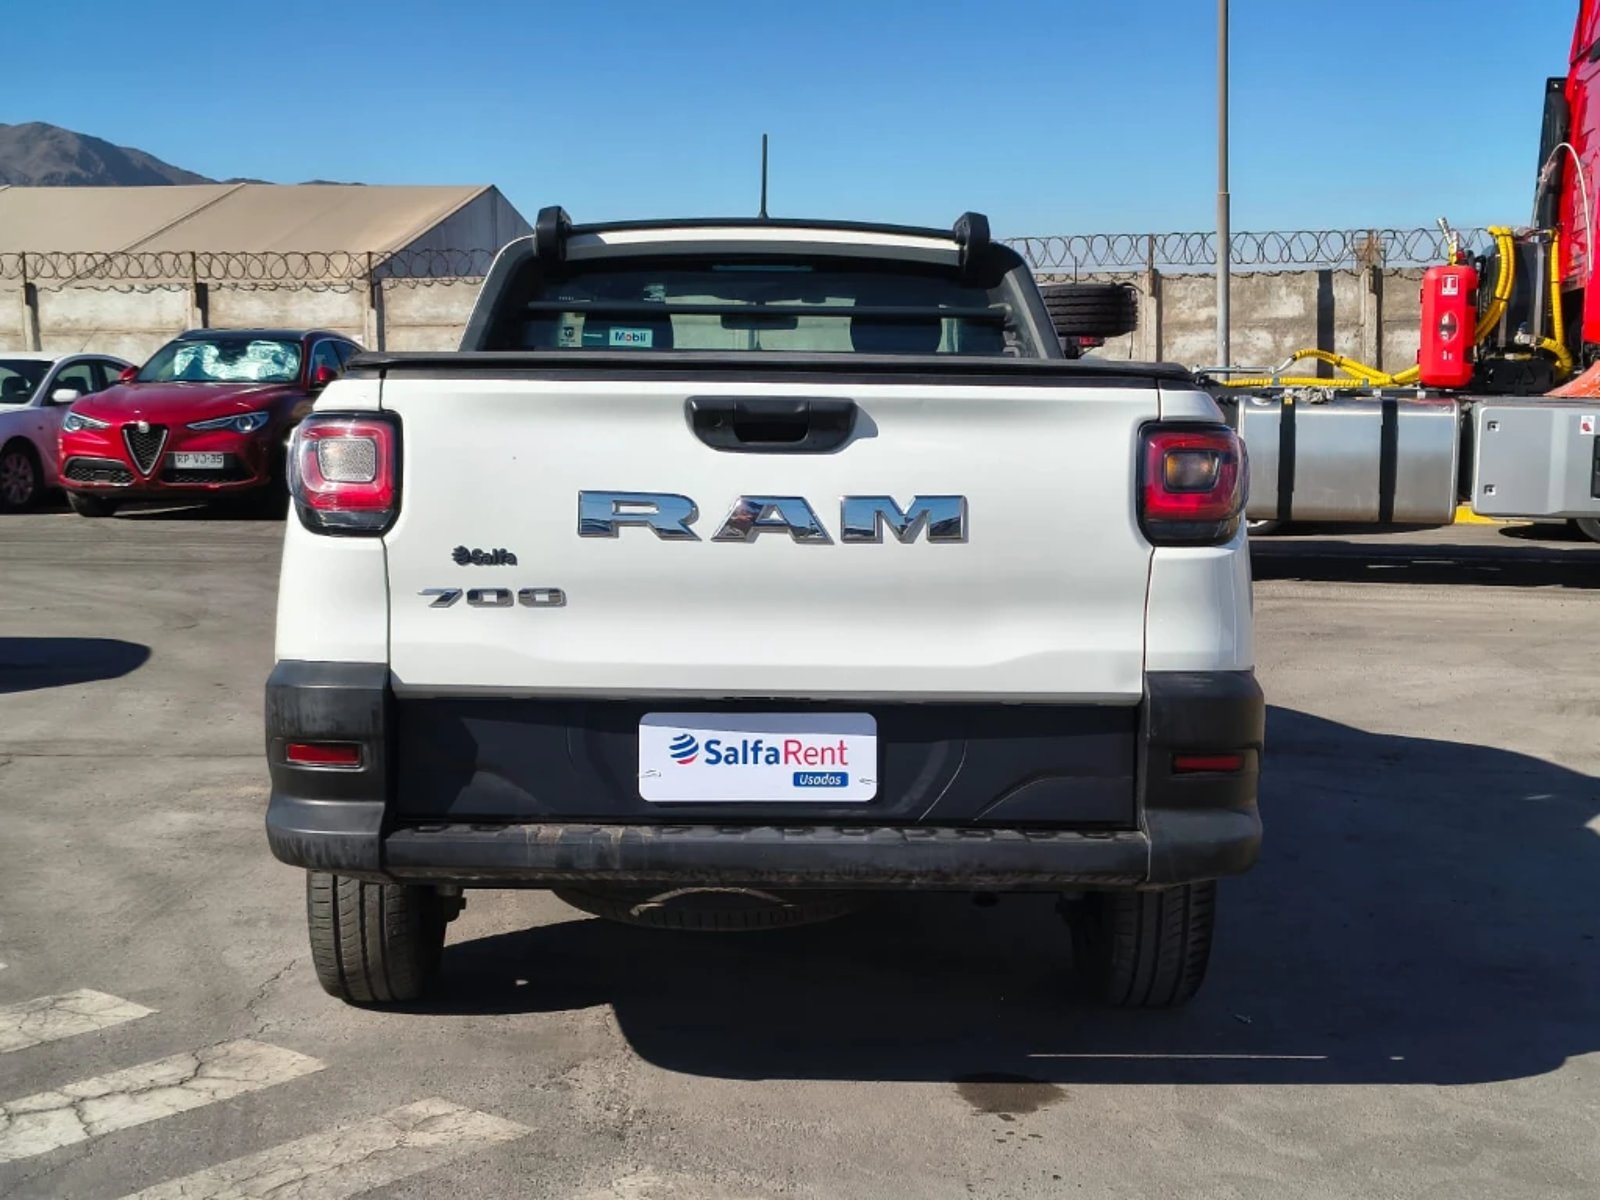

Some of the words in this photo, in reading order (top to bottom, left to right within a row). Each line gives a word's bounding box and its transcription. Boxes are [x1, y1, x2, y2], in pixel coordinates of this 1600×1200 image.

[614, 331, 647, 342] Mobil
[577, 489, 969, 545] RAM
[470, 547, 518, 566] Salfa
[417, 587, 568, 609] 700
[704, 738, 849, 766] SalfaRent
[798, 773, 842, 787] Usados
